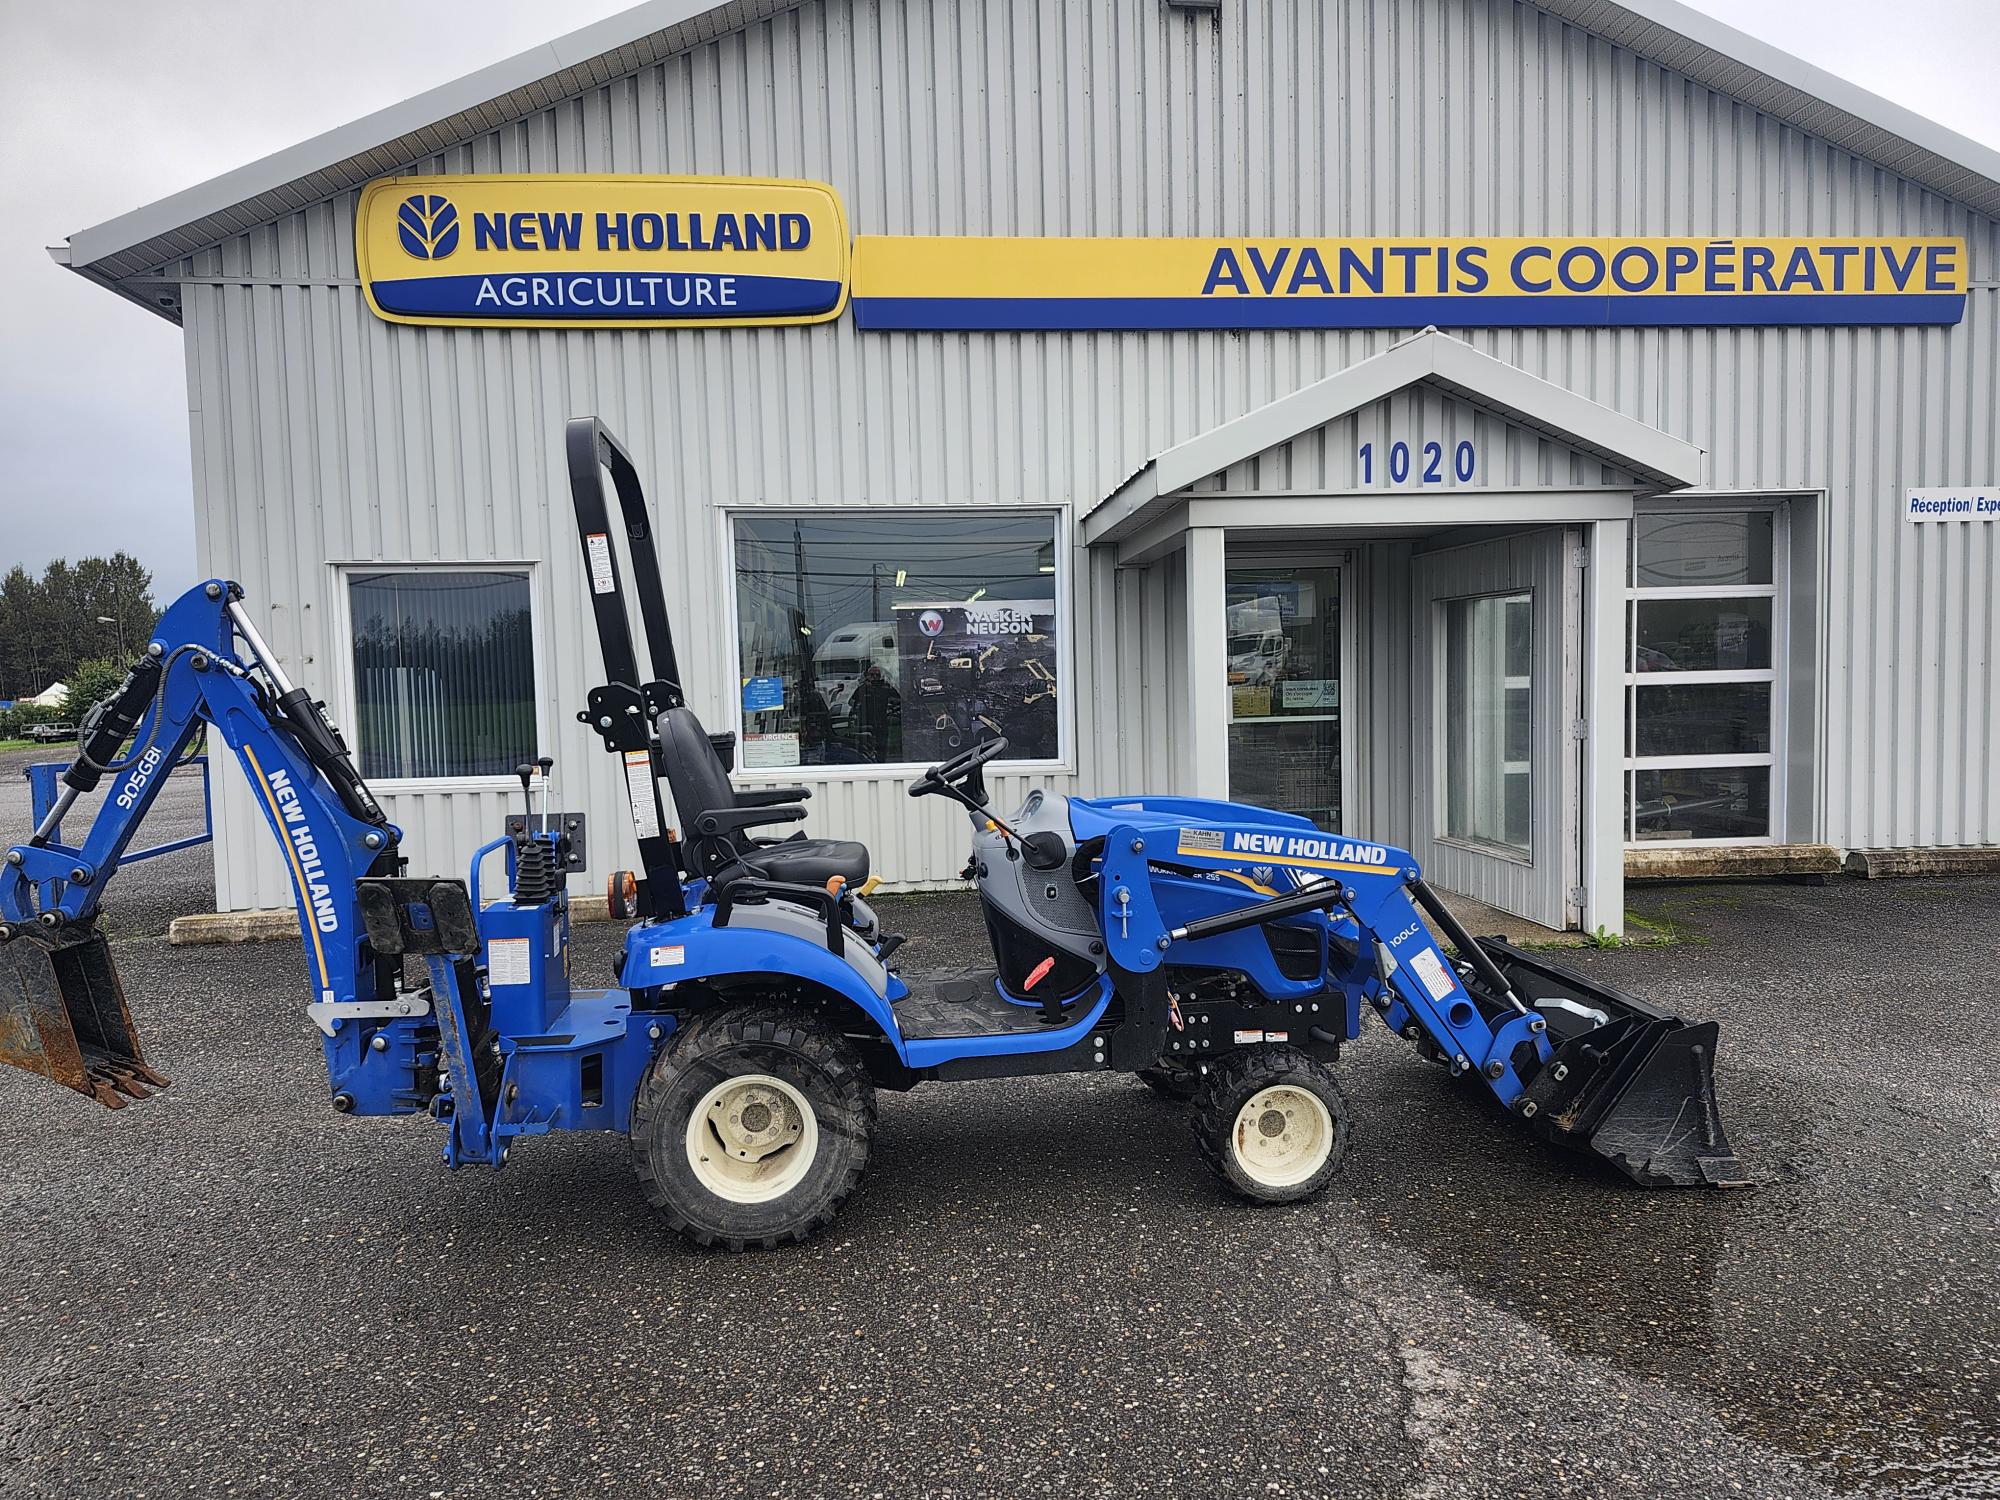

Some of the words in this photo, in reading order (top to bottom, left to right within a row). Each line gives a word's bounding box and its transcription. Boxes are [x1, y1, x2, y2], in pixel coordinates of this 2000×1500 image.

[473, 212, 582, 251] NEW
[595, 212, 811, 251] HOLLAND
[1201, 246, 1489, 295] AVANTIS
[1510, 240, 1957, 293] COOPÉRATIVE
[475, 277, 738, 306] AGRICULTURE
[1359, 440, 1475, 484] 1020
[1910, 496, 1974, 516] Réception/
[964, 611, 1032, 622] WACKER
[966, 622, 1033, 634] NEUSON
[763, 733, 798, 741] URGENCE
[116, 746, 162, 810] 905GBI
[268, 769, 305, 823] NEW
[290, 825, 338, 933] HOLLAND
[1233, 832, 1284, 854] NEW
[1287, 837, 1387, 865] HOLLAND
[1389, 922, 1419, 947] 100LC
